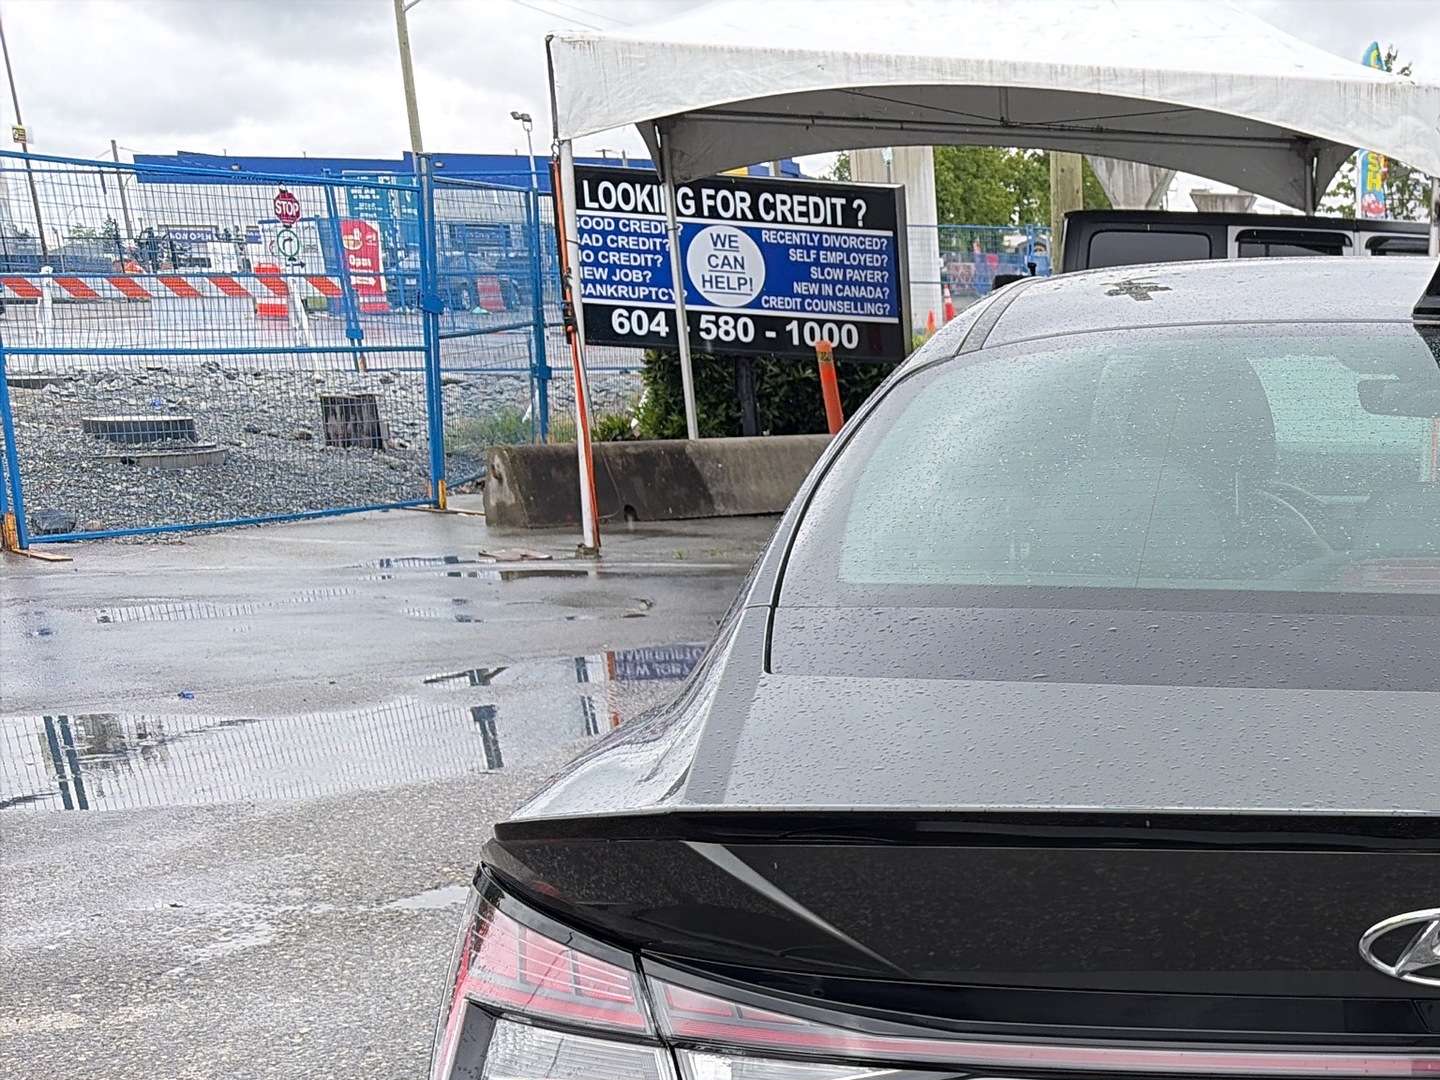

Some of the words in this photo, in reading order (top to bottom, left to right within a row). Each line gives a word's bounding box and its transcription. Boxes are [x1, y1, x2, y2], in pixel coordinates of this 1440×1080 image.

[275, 200, 299, 216] STOP
[701, 188, 753, 220] FOR
[758, 192, 846, 226] CREDIT
[576, 216, 615, 231] OOD
[577, 233, 603, 247] AD
[710, 233, 739, 248] WE
[761, 230, 820, 246] RECENTLY
[822, 234, 888, 250] DIVORCED?
[598, 251, 663, 267] CREDIT?
[707, 254, 745, 270] CAN
[789, 248, 817, 262] SELF
[820, 250, 888, 267] EMPLOYED?
[612, 268, 652, 283] JOB?
[701, 274, 753, 291] HELP!
[810, 266, 843, 280] SLOW
[846, 268, 889, 284] PAYER?
[793, 281, 819, 295] NEW
[822, 283, 833, 297] IN
[835, 284, 889, 300] CANADA?
[761, 295, 801, 310] CREDIT
[805, 299, 890, 315] COUNSELLING?
[611, 308, 669, 337] 604
[699, 314, 755, 343] 580
[786, 320, 859, 349] 1000
